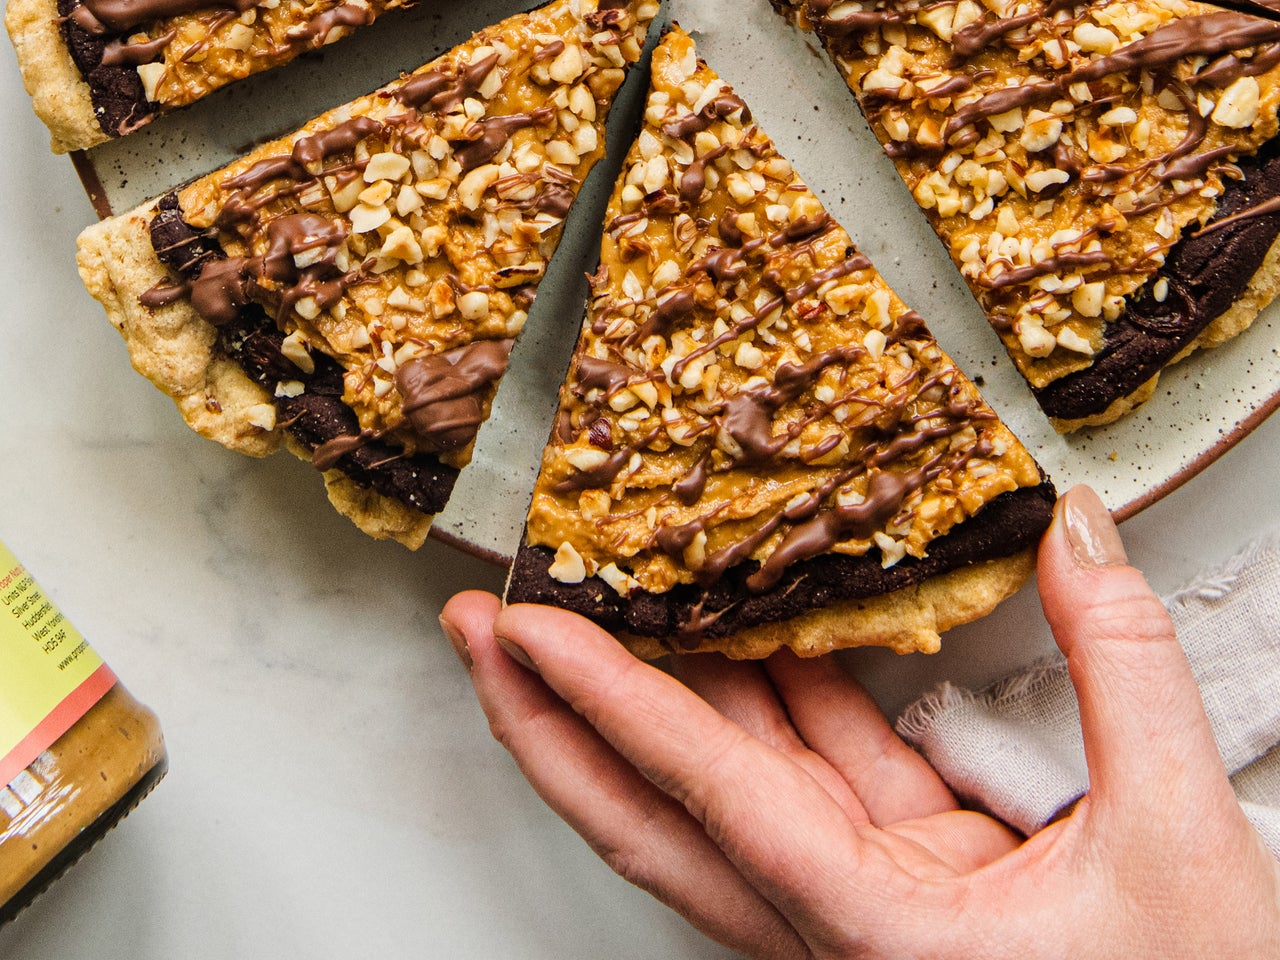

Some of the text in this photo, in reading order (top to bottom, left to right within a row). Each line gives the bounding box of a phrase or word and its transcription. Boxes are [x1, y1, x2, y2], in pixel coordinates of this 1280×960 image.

[1, 589, 20, 606] Units
[11, 601, 29, 618] Silver
[32, 625, 50, 642] West
